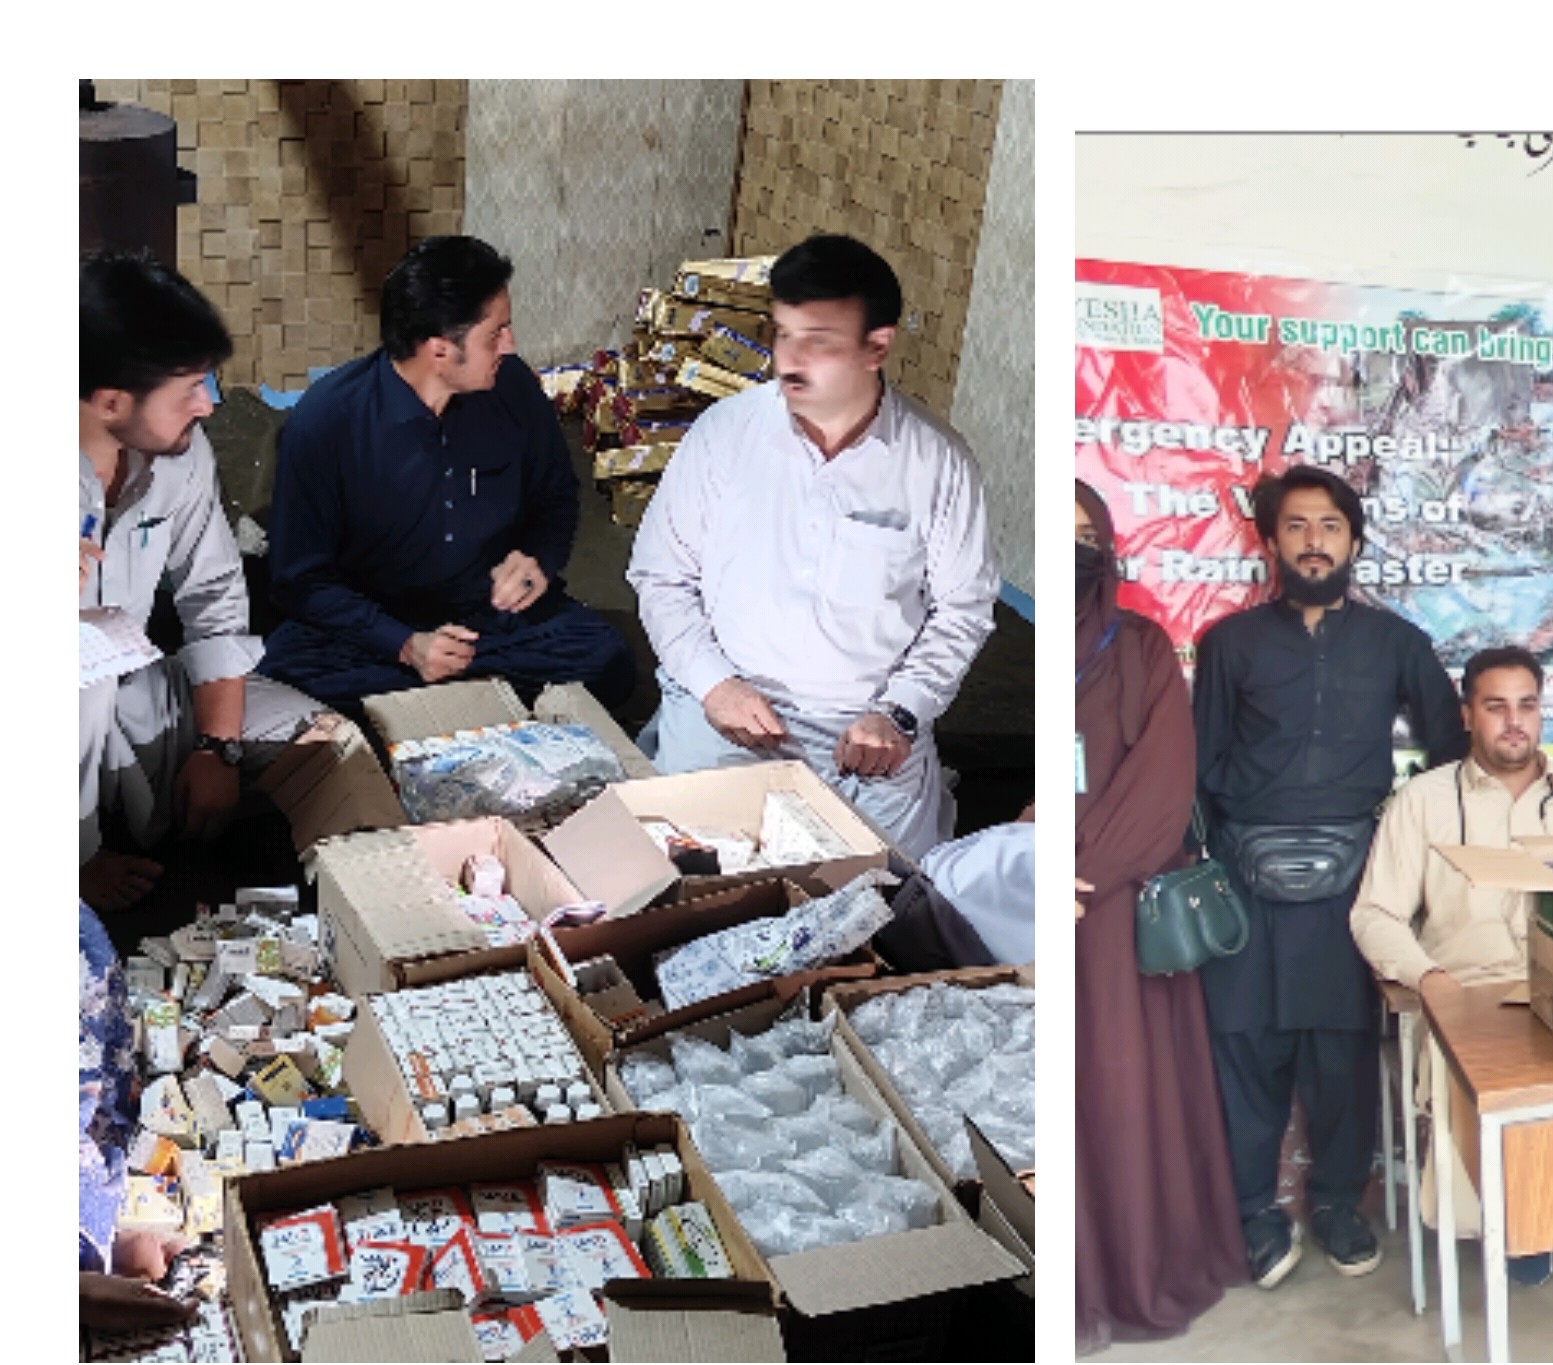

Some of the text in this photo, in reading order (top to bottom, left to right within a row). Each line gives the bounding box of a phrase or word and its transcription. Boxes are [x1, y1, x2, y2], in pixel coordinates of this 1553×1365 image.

[1193, 304, 1272, 344] Your
[1280, 318, 1405, 358] support
[1413, 328, 1469, 356] can
[1479, 328, 1553, 366] bring
[1124, 482, 1219, 518] The
[1425, 491, 1467, 524] of
[1160, 551, 1267, 585] Rain
[1355, 555, 1469, 587] aster
